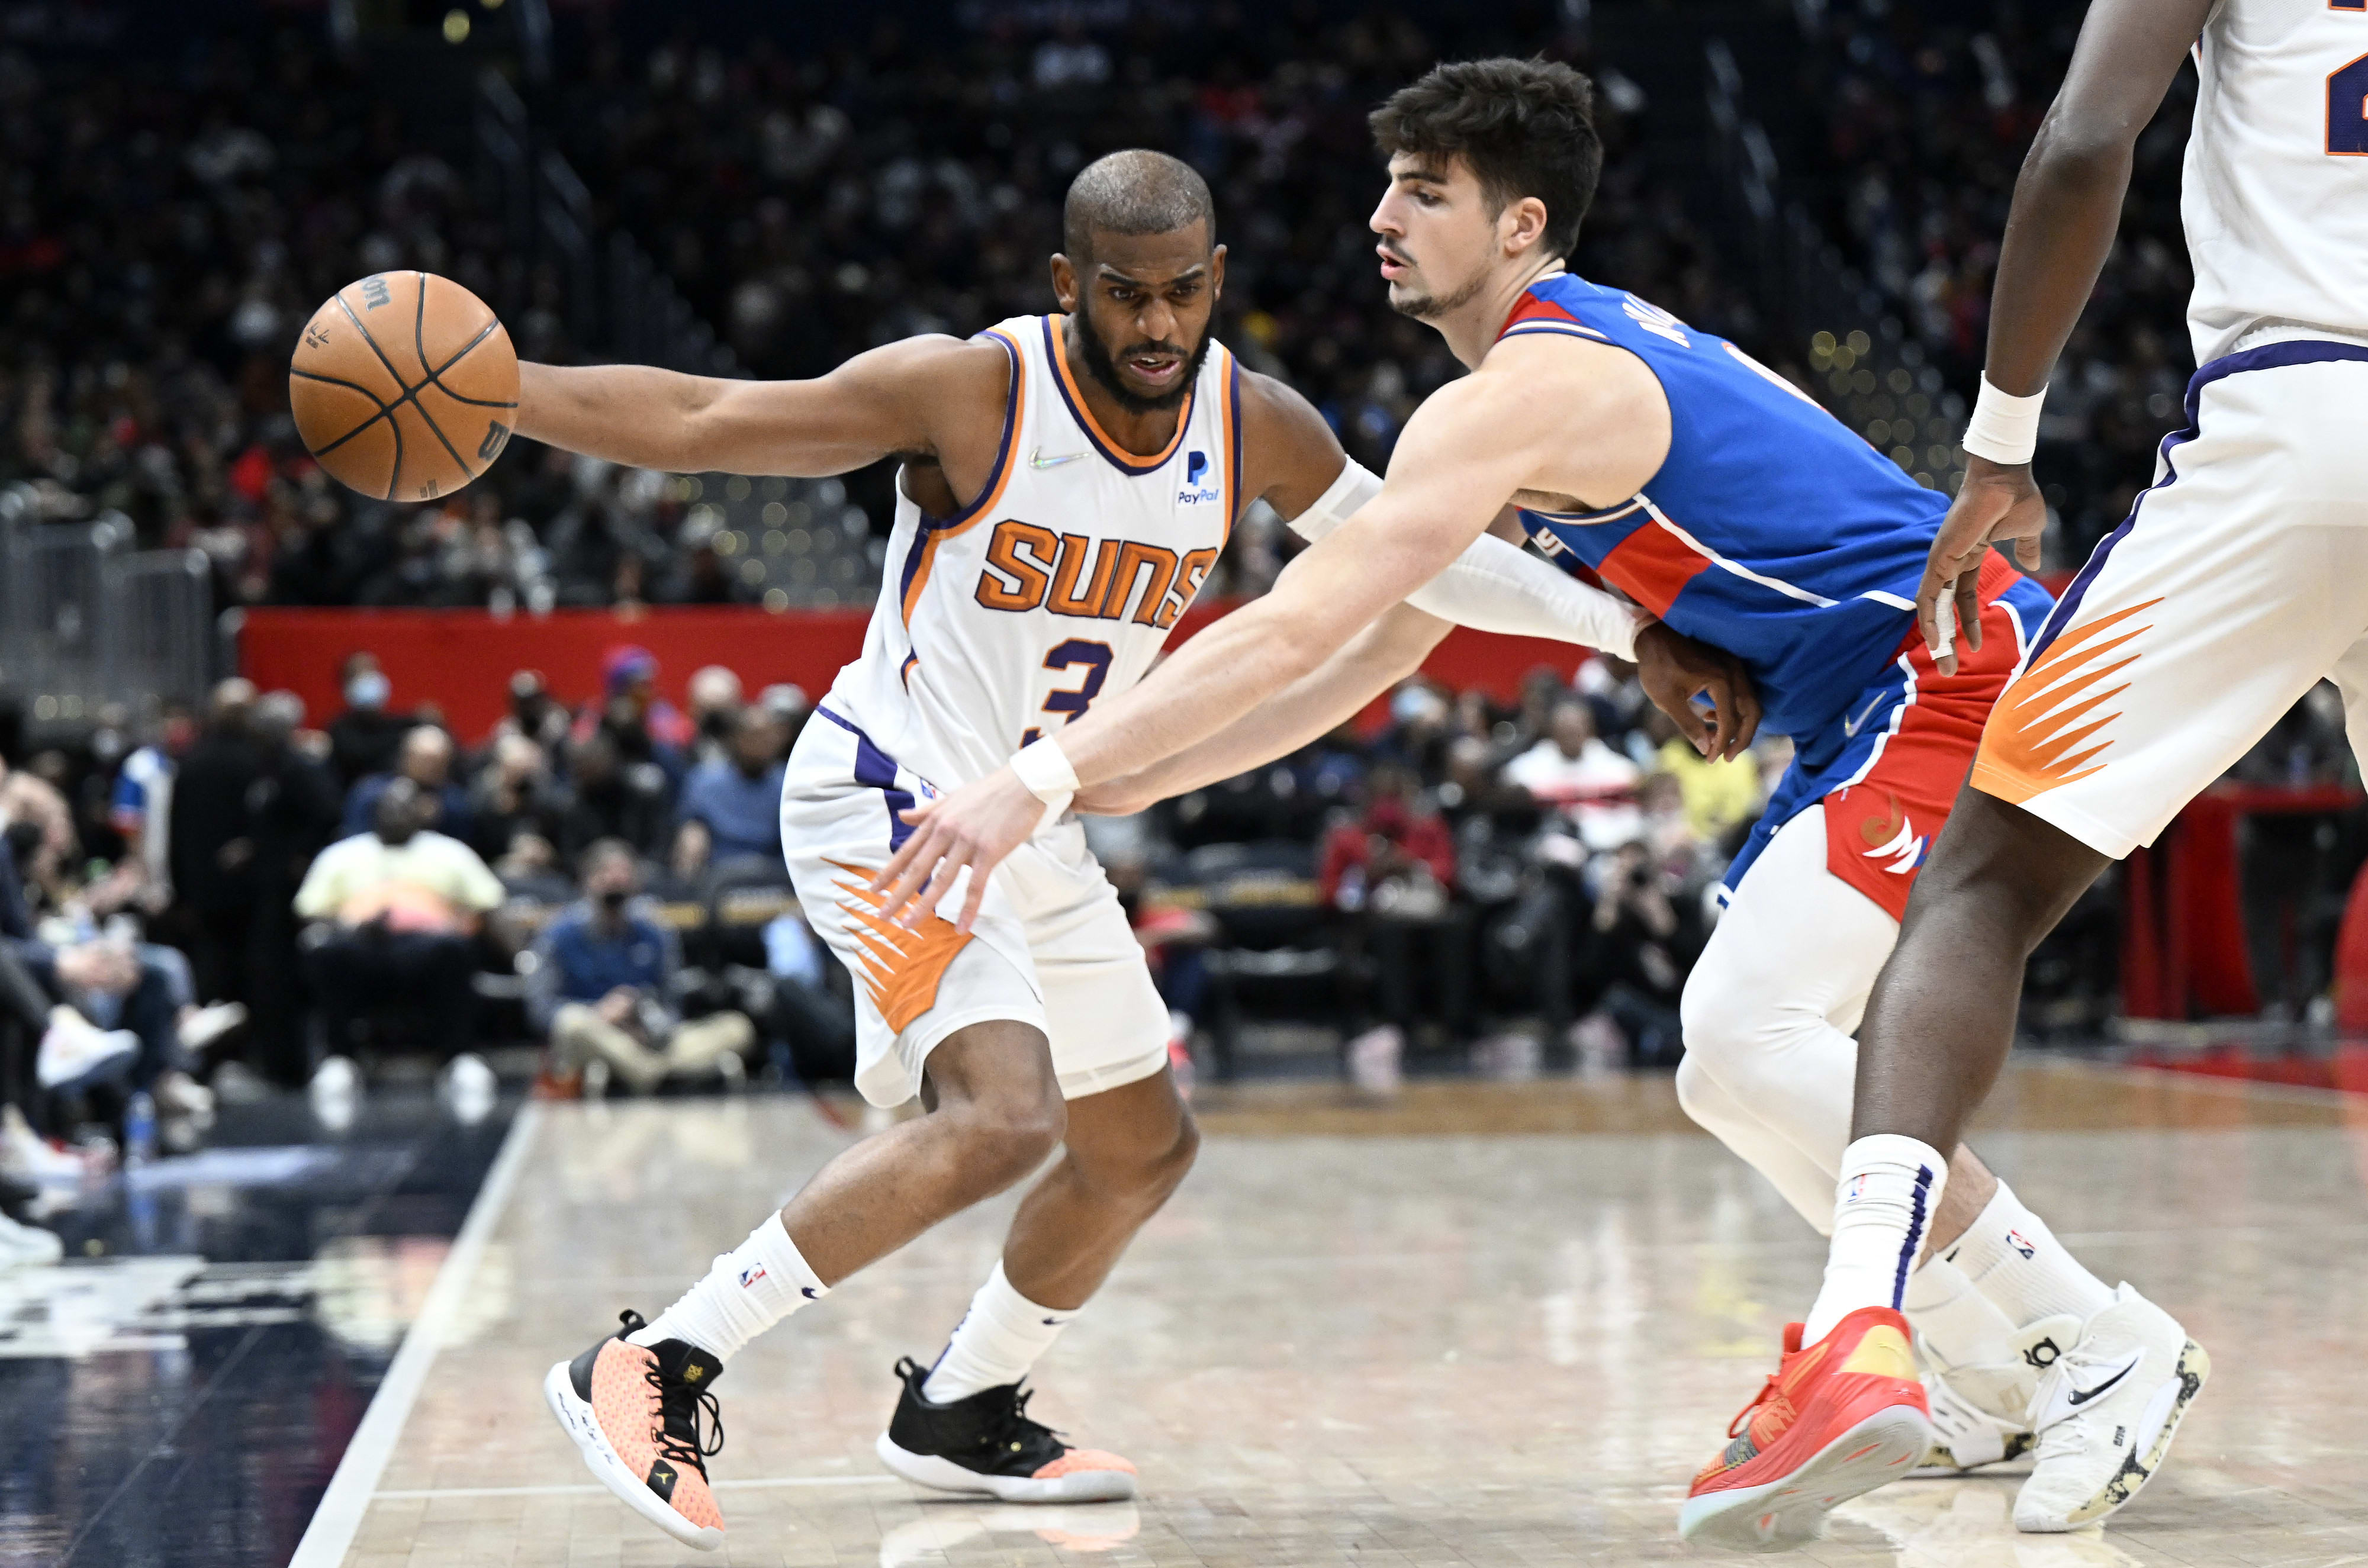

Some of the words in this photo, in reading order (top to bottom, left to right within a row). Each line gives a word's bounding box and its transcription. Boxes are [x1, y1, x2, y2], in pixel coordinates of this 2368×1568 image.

[1178, 488, 1219, 504] PayPal
[974, 519, 1217, 630] SUNS
[1018, 637, 1114, 750] 3
